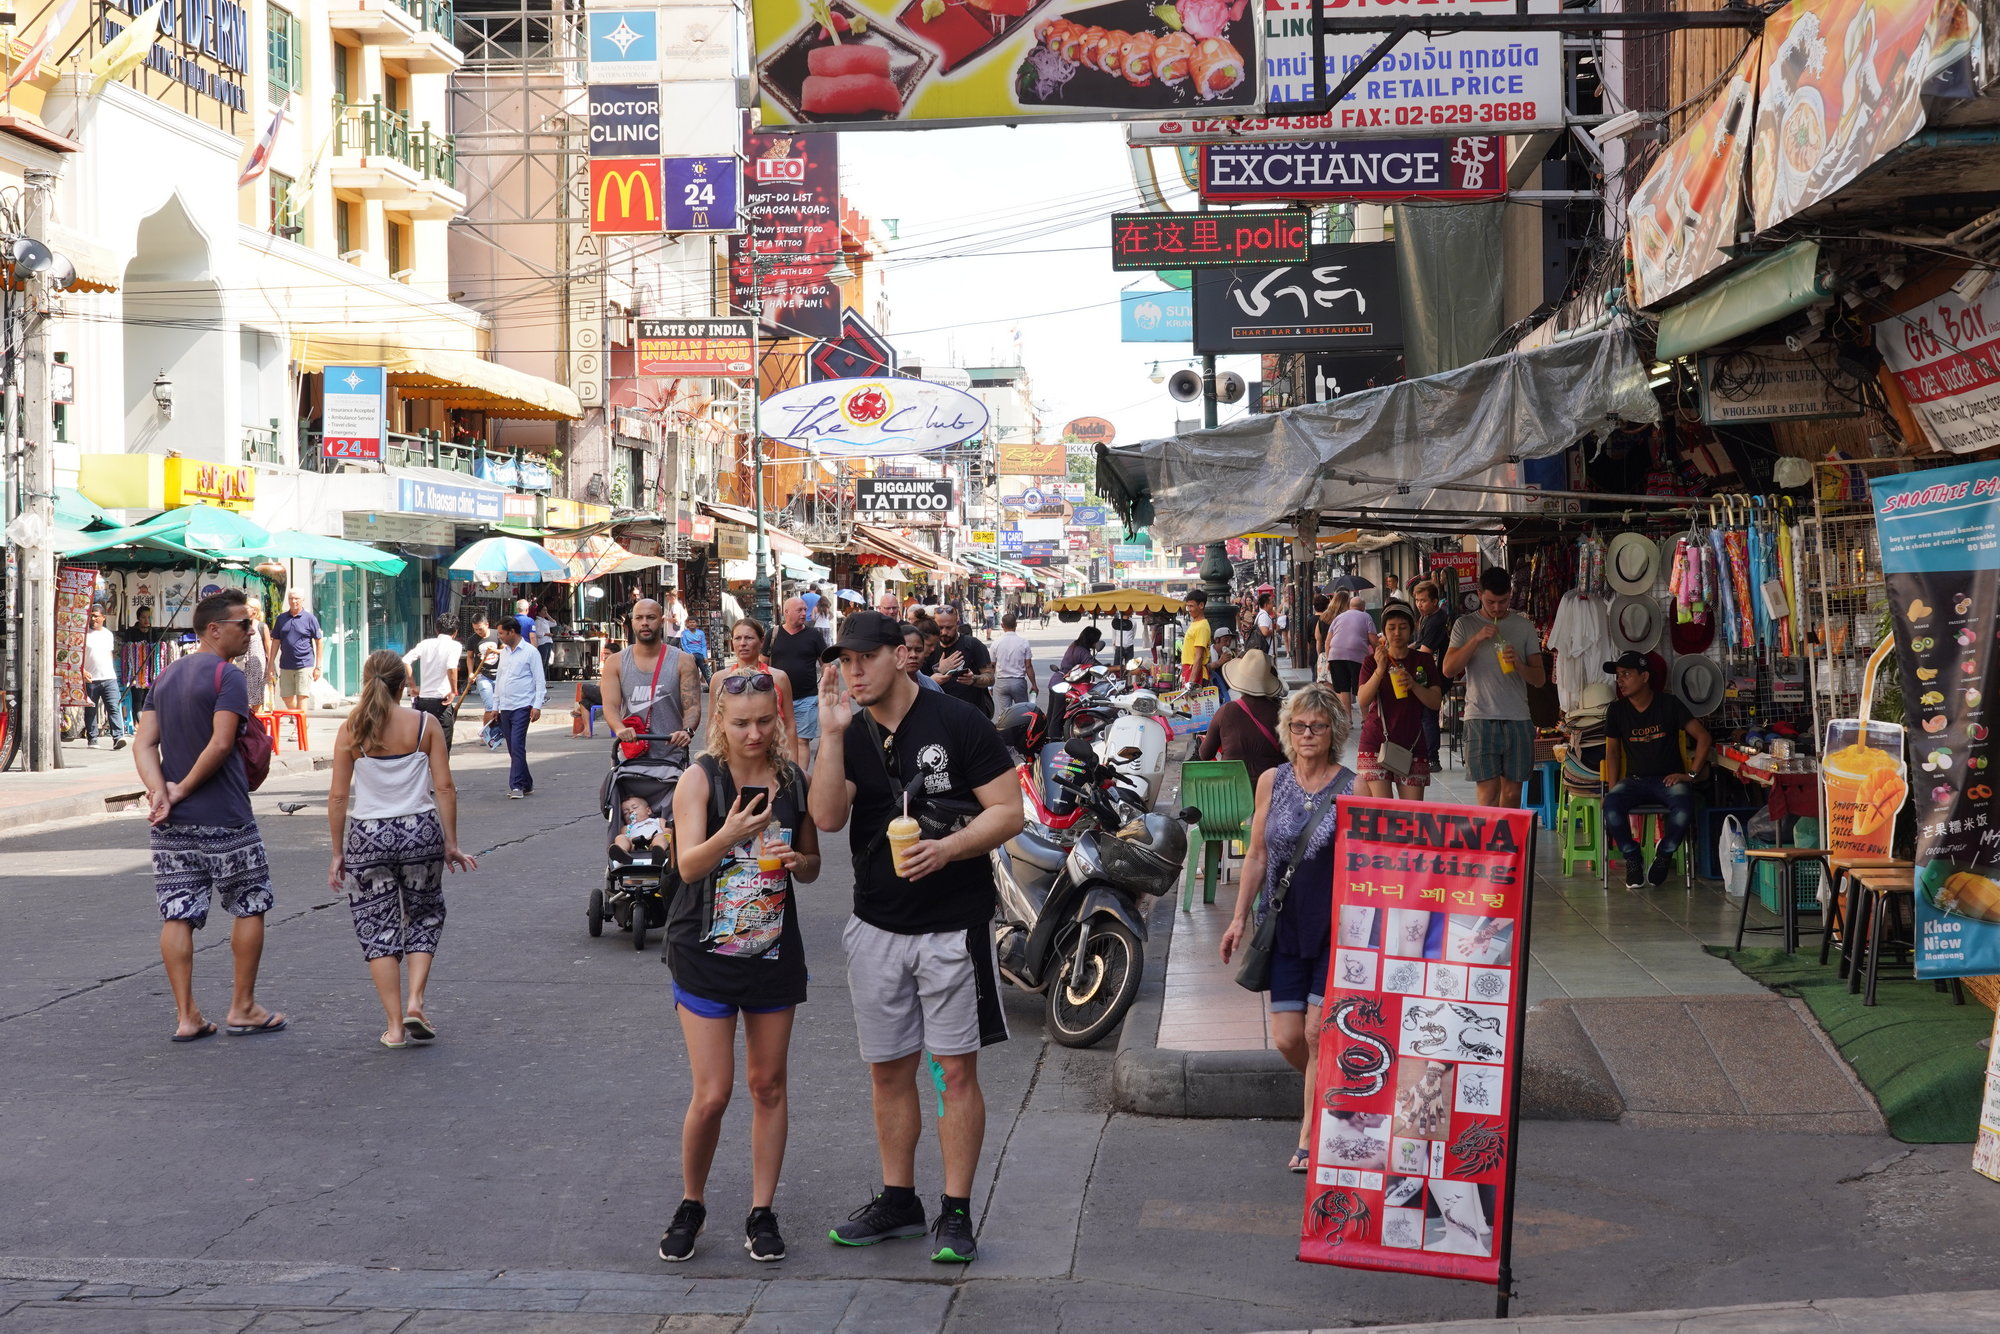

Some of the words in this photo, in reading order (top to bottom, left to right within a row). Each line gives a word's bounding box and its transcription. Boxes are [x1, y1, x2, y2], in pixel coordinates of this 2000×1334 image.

[590, 101, 659, 116] DOCTOR
[590, 124, 659, 142] CLINIC
[759, 161, 802, 178] LEO
[1210, 152, 1440, 186] EXCHANGE
[684, 183, 716, 205] 24
[748, 193, 790, 202] MUST-DO
[792, 193, 814, 202] LIST
[753, 205, 799, 214] KHAOSAN
[801, 205, 830, 214] ROAD:
[776, 225, 802, 233] STREET
[803, 225, 823, 233] FOOD
[774, 239, 803, 247] TATTOO
[789, 286, 809, 295] YOU
[769, 299, 795, 308] HAVE
[798, 299, 823, 308] FUN!
[644, 324, 686, 336] TASTE
[688, 324, 706, 336] OF
[708, 324, 747, 336] INDIA
[1235, 329, 1268, 337] CHART
[1271, 328, 1292, 336] BAR
[1306, 325, 1371, 335] RESTAURANT
[1938, 303, 1988, 348] Bar
[640, 340, 702, 361] INDIAN
[705, 340, 751, 361] FOOD
[1722, 403, 1778, 417] WHOLESALER
[1789, 403, 1818, 413] RETAIL
[1071, 423, 1106, 435] Buddy
[336, 440, 362, 456] 24
[873, 482, 935, 493] BIGGAINK
[414, 484, 426, 508] Dr.
[427, 487, 457, 512] Khaosan
[862, 494, 948, 510] TATTOO
[1880, 482, 1970, 513] SMOOTHIE
[1007, 531, 1023, 542] CARD
[1933, 528, 1957, 537] natural
[1890, 544, 1905, 552] with
[1911, 541, 1931, 549] choice
[1941, 537, 1965, 546] variety
[1967, 533, 1996, 542] smoothie
[1832, 800, 1869, 812] SMOOTHIE
[1832, 813, 1854, 824] SHAKE
[1346, 806, 1518, 853] HENNA
[1831, 826, 1853, 837] JUICE
[1831, 839, 1866, 852] SMOOTHIE
[1867, 844, 1888, 854] BOWL
[1345, 852, 1517, 885] paitting
[728, 874, 778, 888] adidas
[1350, 881, 1404, 900] 바디
[1923, 920, 1962, 935] Khao
[1923, 937, 1962, 951] Niew
[1924, 952, 1965, 961] Mamuang
